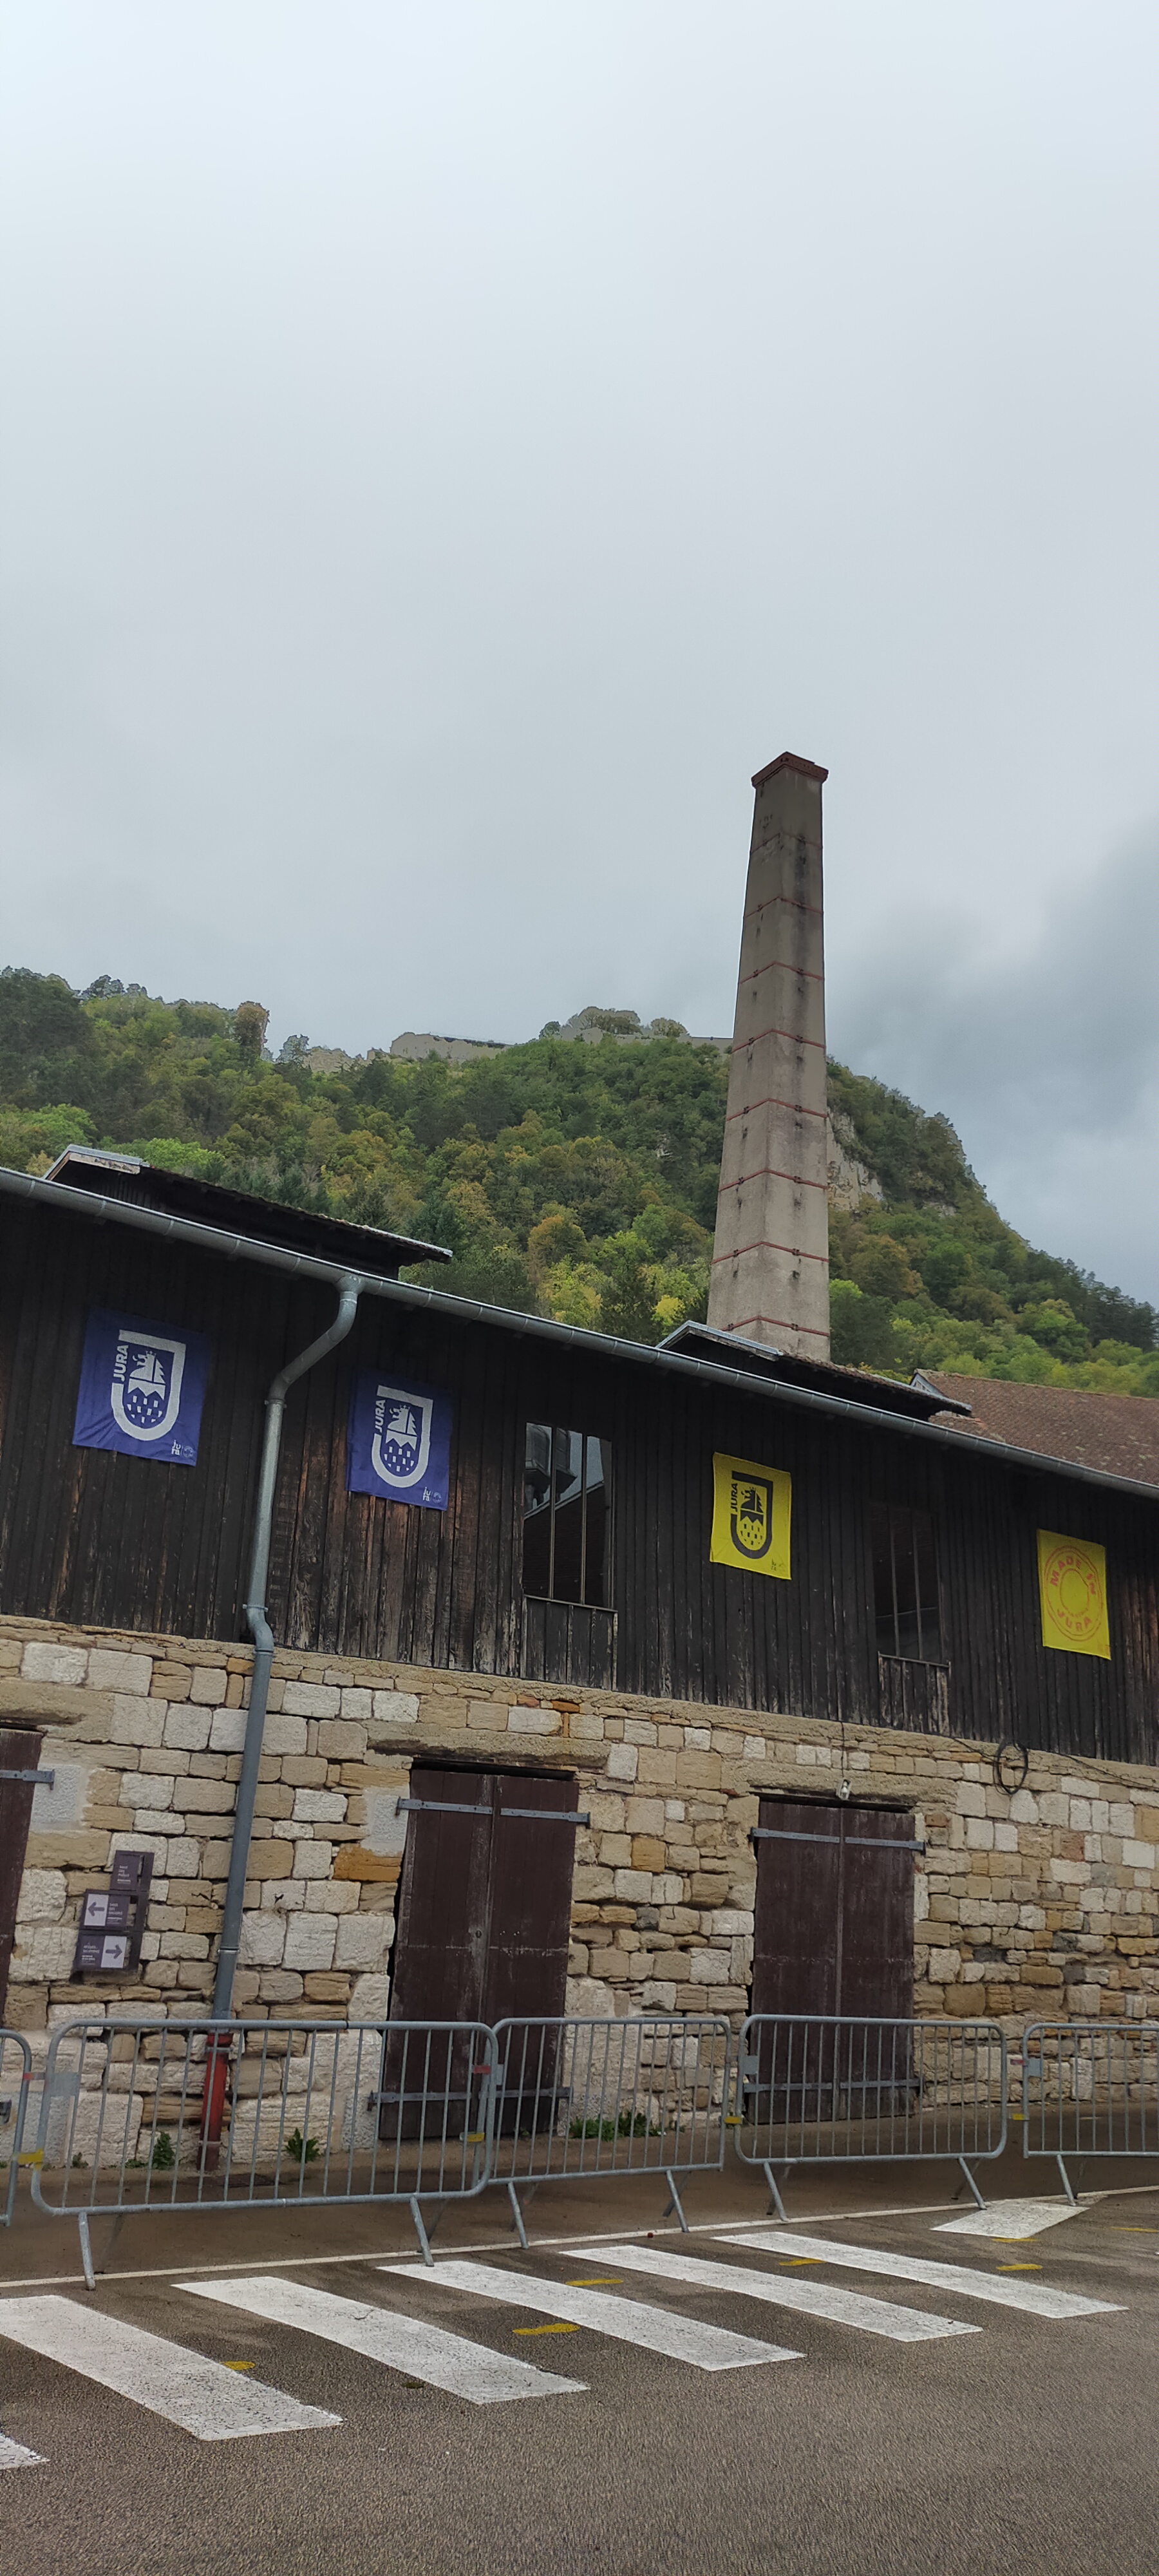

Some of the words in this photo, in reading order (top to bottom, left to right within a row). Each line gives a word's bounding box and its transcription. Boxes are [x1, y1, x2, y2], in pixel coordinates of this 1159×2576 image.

[113, 1345, 129, 1382] JURA
[375, 1399, 386, 1434] JURA
[730, 1482, 739, 1512] JURA
[1050, 1555, 1082, 1587] MADE
[1057, 1609, 1092, 1631] JURA
